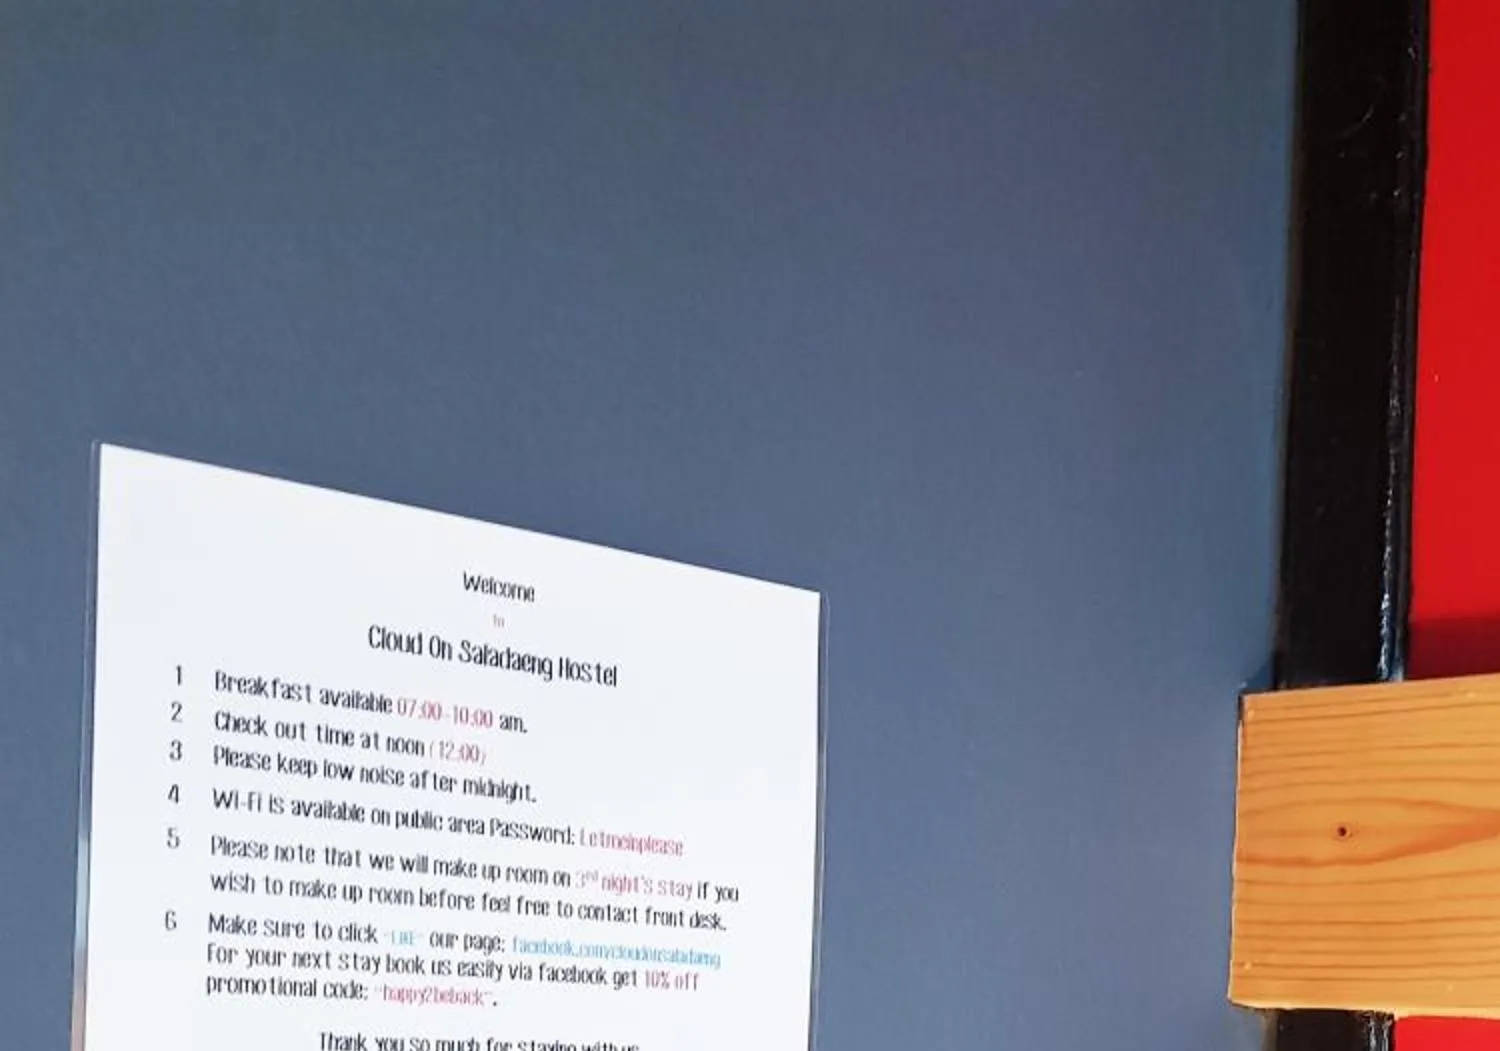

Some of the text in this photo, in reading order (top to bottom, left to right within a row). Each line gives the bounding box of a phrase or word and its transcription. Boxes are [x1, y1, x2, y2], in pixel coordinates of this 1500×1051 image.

[463, 571, 535, 603] Welcome
[368, 624, 618, 688] Cloud On Saladaeng Hostel
[176, 665, 182, 686] 1
[214, 669, 311, 704] Breakfast
[319, 688, 393, 715] available
[499, 714, 528, 734] am.
[171, 701, 487, 766] 2 Check out time at noon (12:00)
[169, 739, 538, 806] 3 Please keep low noise after midnight.
[167, 783, 180, 805] 4
[269, 793, 285, 815] is
[290, 798, 365, 825] available
[371, 807, 391, 827] on
[395, 808, 443, 832] public
[447, 815, 485, 836] area
[489, 816, 575, 846] Password:
[167, 826, 180, 850] 5
[211, 834, 269, 862] Please
[274, 843, 315, 865] note
[324, 846, 362, 869] that
[368, 852, 394, 872] we
[400, 853, 429, 875] will
[433, 857, 477, 880] make
[481, 862, 501, 884] up
[505, 865, 549, 886] room
[553, 868, 571, 889] on
[601, 873, 653, 897] night's
[657, 878, 693, 901] stay
[697, 880, 709, 901] if
[714, 884, 739, 905] you
[164, 908, 177, 932] 6
[208, 911, 257, 937] Make
[262, 918, 305, 939] sure
[315, 919, 333, 941] to
[338, 922, 378, 945] click
[429, 930, 458, 951] our
[463, 933, 505, 957] page:
[210, 870, 727, 932] wish to make up room before feel free to contact front desk.
[206, 974, 317, 998] promotional
[207, 943, 700, 993] For your next stay book us easily via facebook get 10% off
